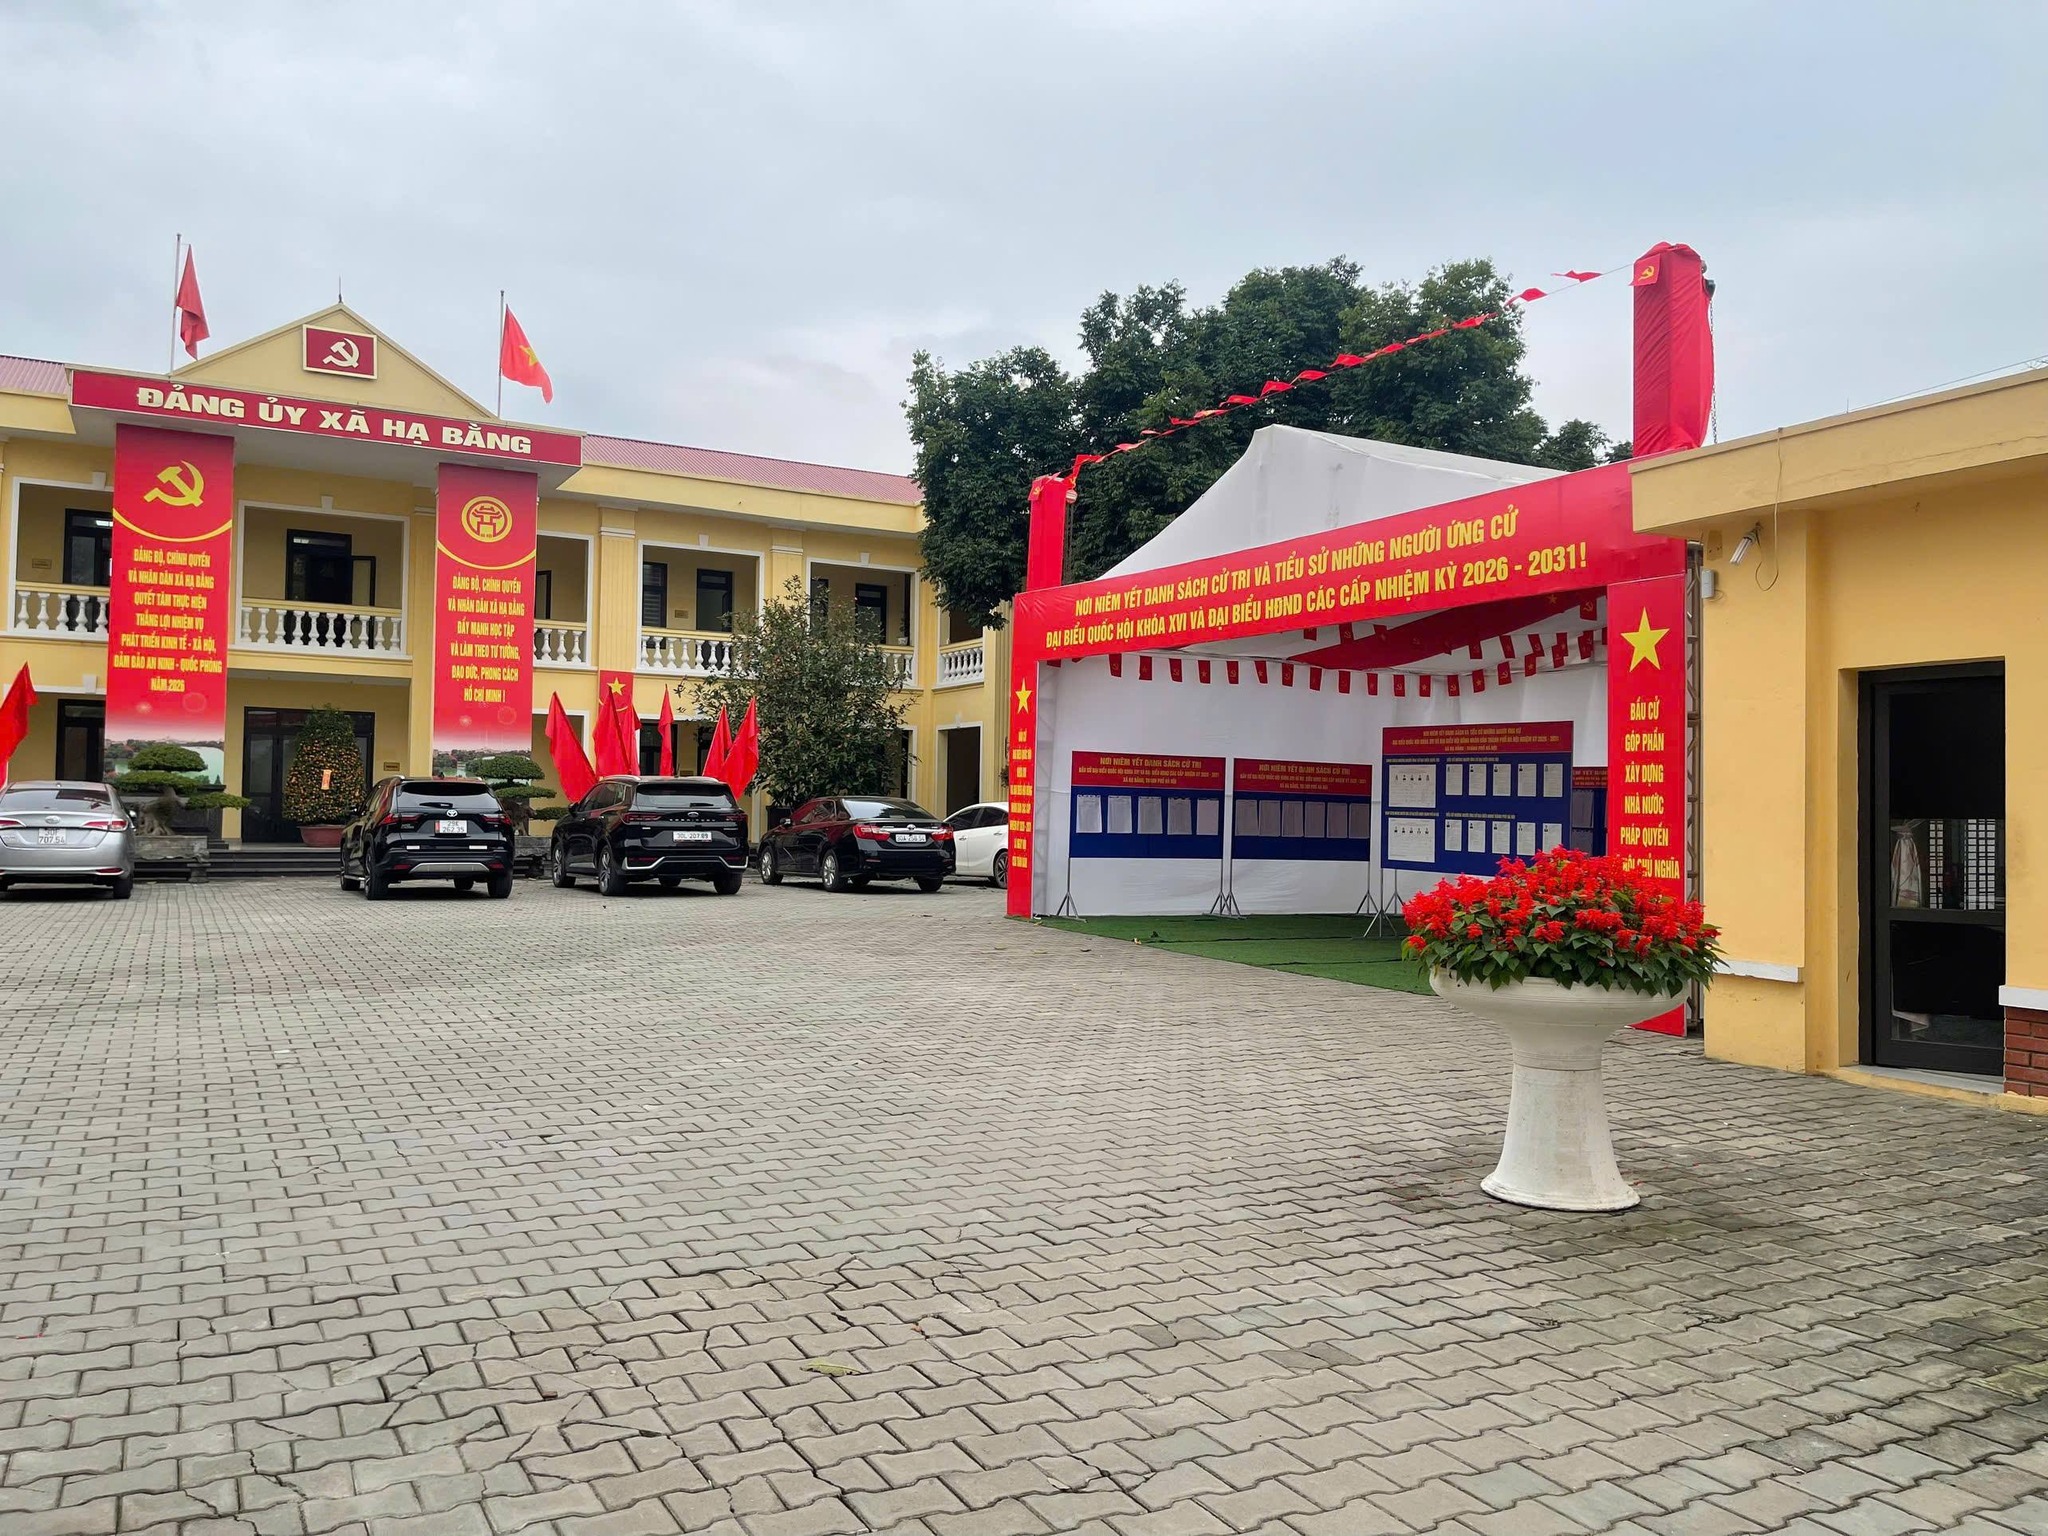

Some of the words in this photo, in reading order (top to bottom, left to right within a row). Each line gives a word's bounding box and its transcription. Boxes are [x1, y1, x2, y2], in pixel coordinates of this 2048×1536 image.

[137, 384, 245, 418] ĐẢNG
[258, 396, 307, 425] ỦY
[319, 409, 370, 434] XÃ
[383, 418, 430, 445] HẠ
[442, 422, 531, 454] BẰNG
[1076, 597, 1092, 616] NƠI
[1095, 591, 1121, 613] NIÊM
[1124, 585, 1142, 609] YẾT
[1145, 584, 1174, 606] DANH
[1177, 576, 1208, 600] SÁCH
[1211, 568, 1229, 594] CỬ
[1231, 568, 1250, 590] TRI
[1254, 562, 1271, 586] VÀ
[1274, 551, 1304, 582] TIỂU
[1308, 546, 1329, 576] SỬ
[1332, 541, 1385, 571] NHỮNG
[1389, 524, 1442, 560] NGƯỜI
[1447, 519, 1484, 549] ỨNG
[1490, 504, 1519, 540] CỬ
[1046, 631, 1061, 651] ĐẠI
[1064, 622, 1085, 645] BIỂU
[1088, 618, 1114, 644] QUỐC
[1116, 618, 1134, 644] HỘI
[1137, 614, 1165, 637] KHÓA
[1169, 612, 1187, 633] XVI
[1190, 606, 1205, 630] VÀ
[1208, 606, 1229, 631] ĐẠI
[1232, 594, 1261, 623] BIỂU
[1265, 593, 1302, 619] HĐND
[1306, 585, 1335, 612] CÁC
[1339, 575, 1370, 606] CẤP
[1375, 569, 1429, 601] NHIỆM
[1435, 561, 1457, 591] KỲ
[1462, 556, 1508, 587] 2026
[1630, 696, 1646, 720] BẦU
[1648, 695, 1660, 720] CỬ
[1625, 729, 1641, 751] GÓP
[1642, 726, 1664, 751] PHẦN
[1625, 761, 1640, 783] XÂY
[1642, 763, 1664, 787] DỰNG
[1625, 792, 1640, 814] NHÀ
[1642, 792, 1664, 815] NƯỚC
[1620, 823, 1641, 845] PHÁP
[1642, 821, 1668, 848] QUYỀN
[1655, 856, 1680, 879] NGHĨA
